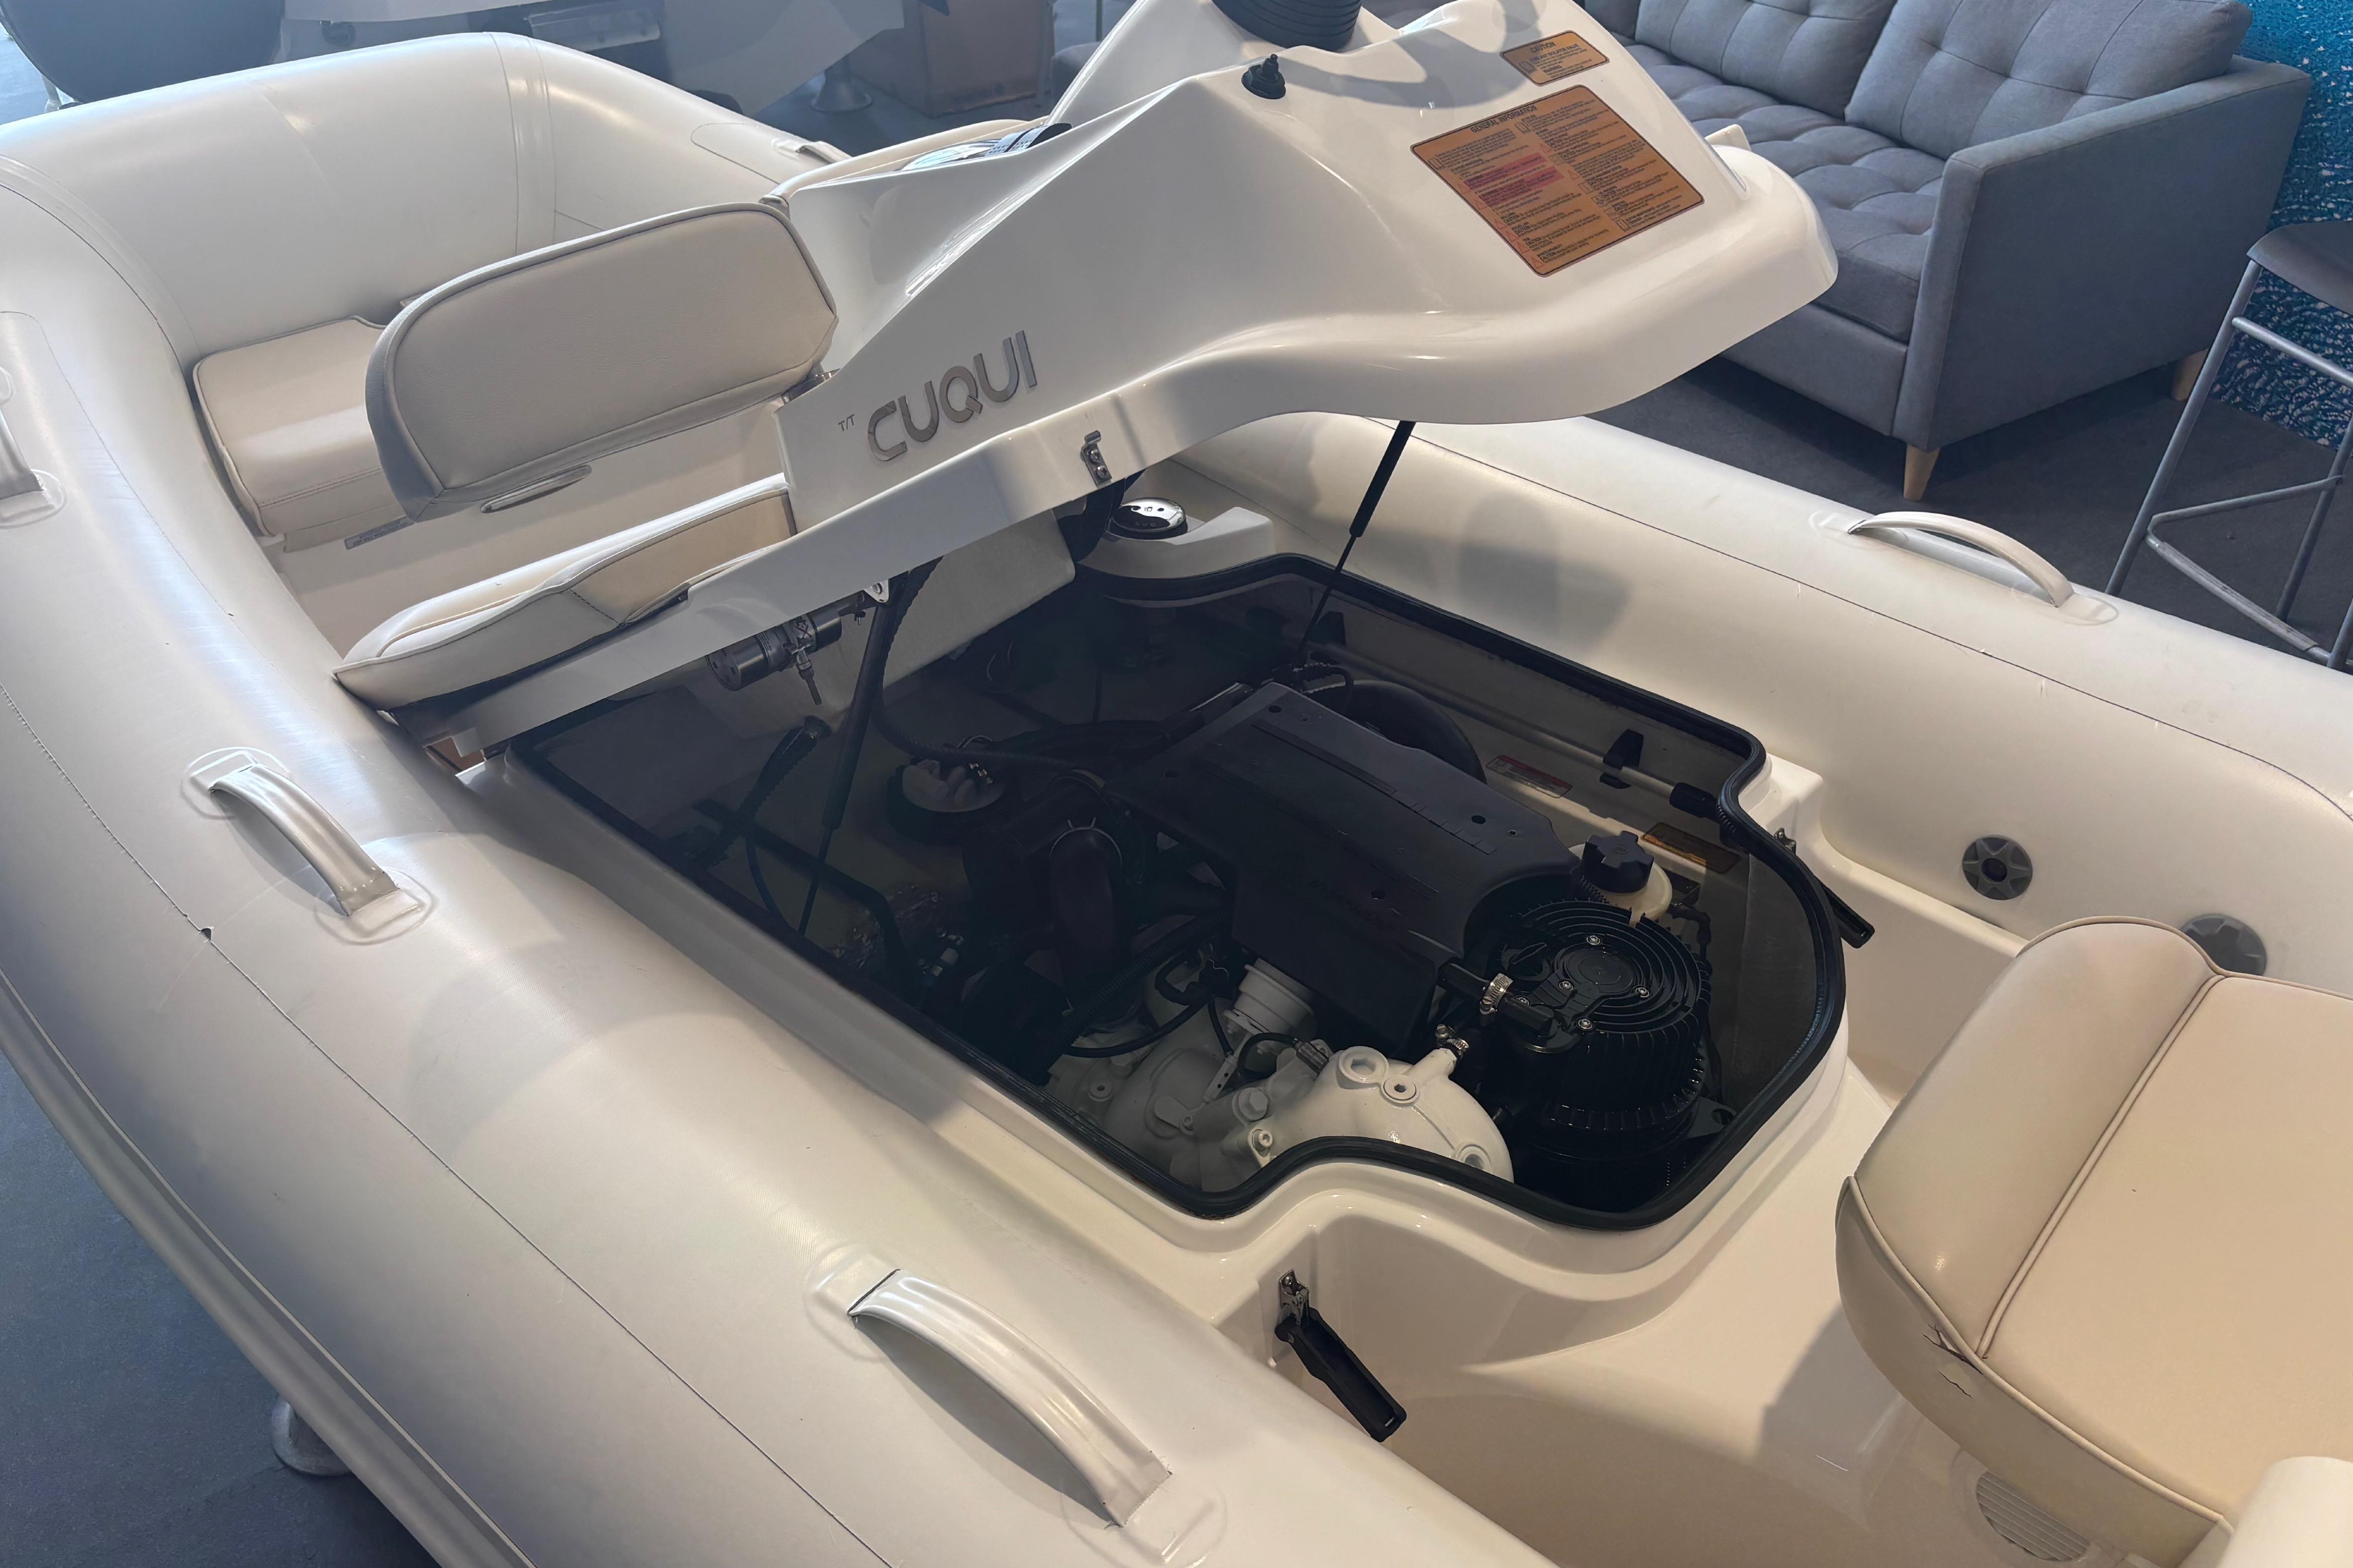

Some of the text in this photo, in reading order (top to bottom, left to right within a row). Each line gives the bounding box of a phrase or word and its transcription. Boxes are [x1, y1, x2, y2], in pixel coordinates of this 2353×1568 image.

[1530, 41, 1556, 53] CAUTION
[1471, 119, 1499, 132] GENERAL
[1499, 105, 1537, 122] INFORMATION
[838, 330, 1037, 461] T/T CUQUI
